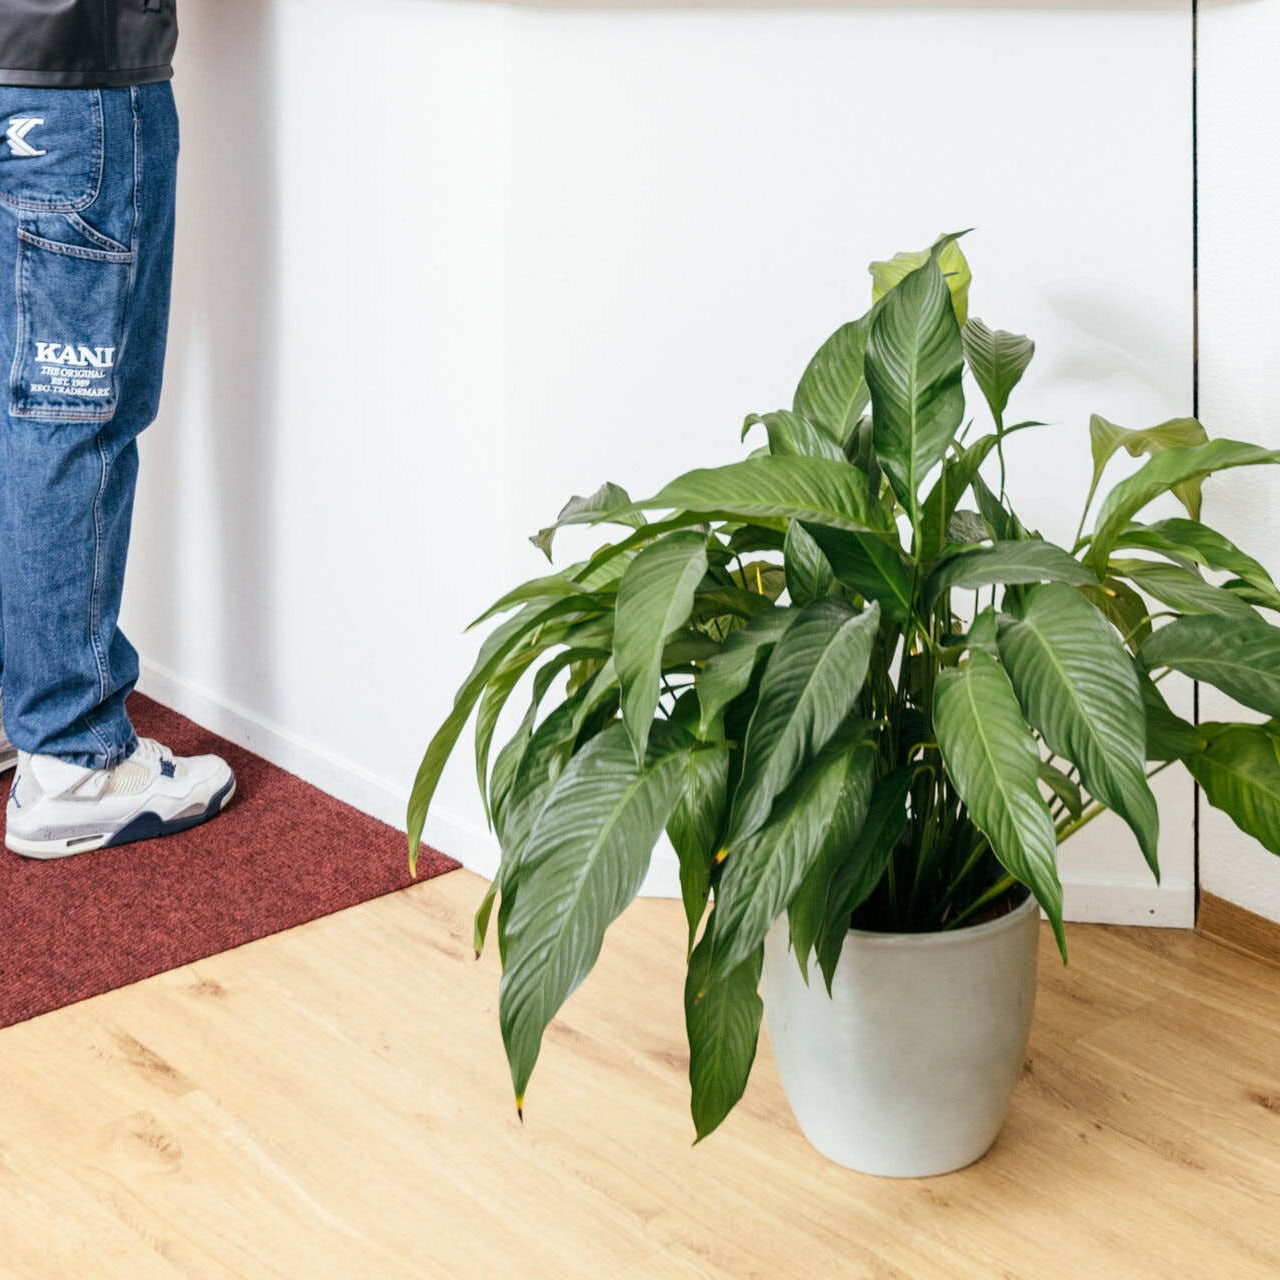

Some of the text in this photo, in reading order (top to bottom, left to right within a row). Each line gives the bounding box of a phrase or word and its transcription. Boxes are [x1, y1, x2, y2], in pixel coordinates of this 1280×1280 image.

[34, 342, 116, 368] KANI
[41, 366, 106, 379] THE ORIGINAL
